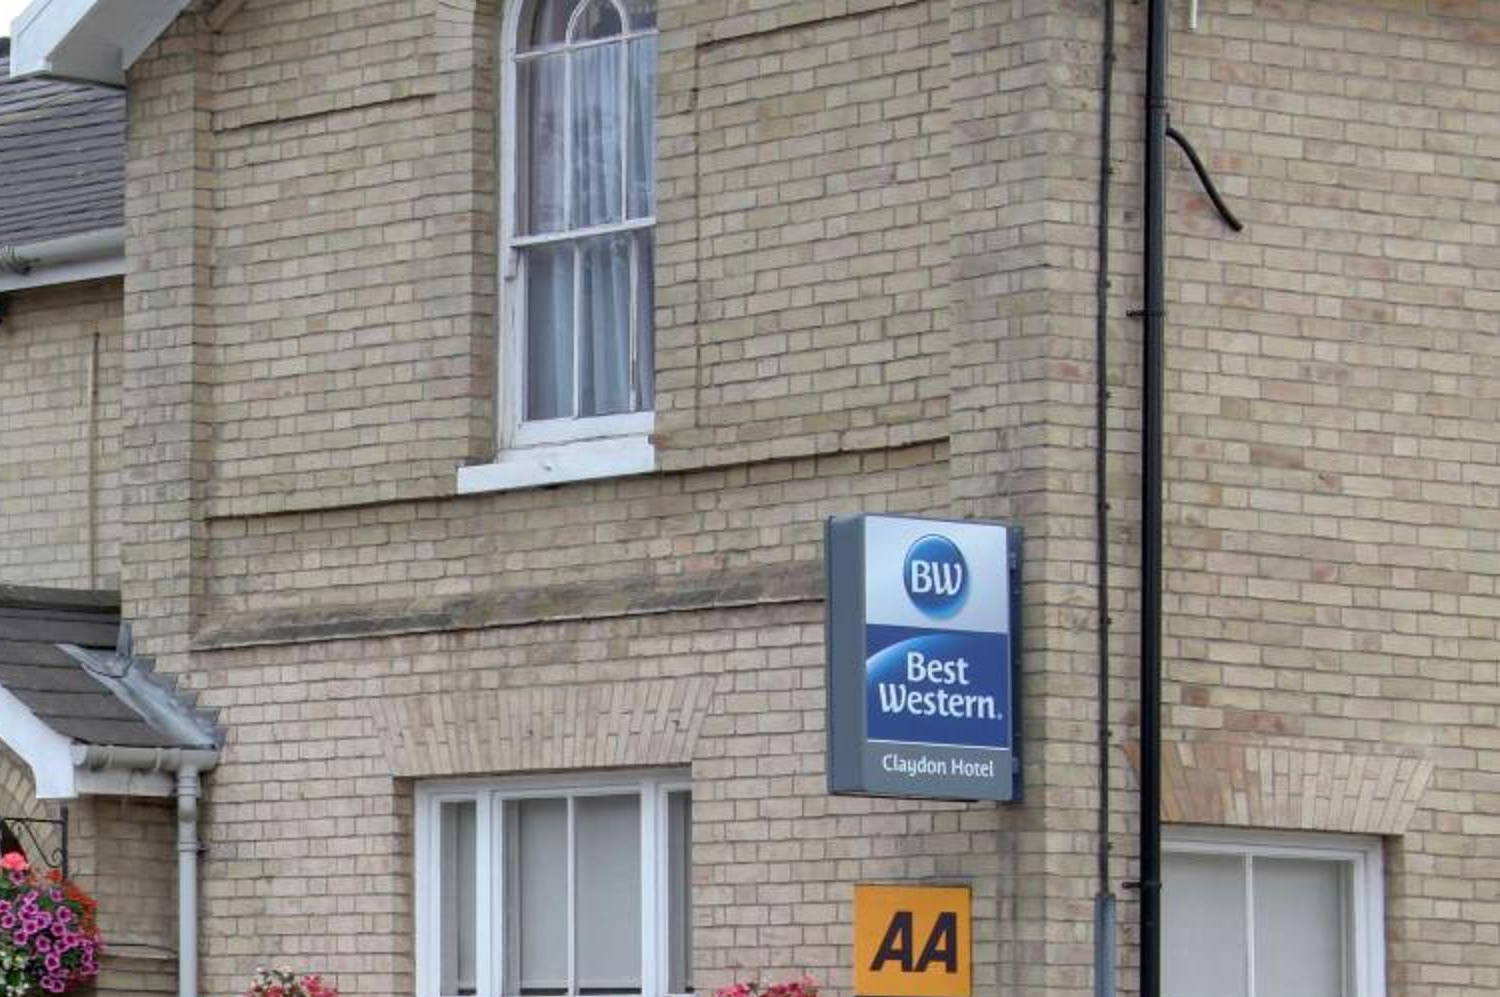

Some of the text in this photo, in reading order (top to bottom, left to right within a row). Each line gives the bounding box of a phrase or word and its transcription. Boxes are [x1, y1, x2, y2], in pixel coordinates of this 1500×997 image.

[911, 559, 963, 595] BW
[907, 652, 970, 685] Best
[882, 754, 995, 777] Claydon Hotel
[869, 911, 958, 974] AA
